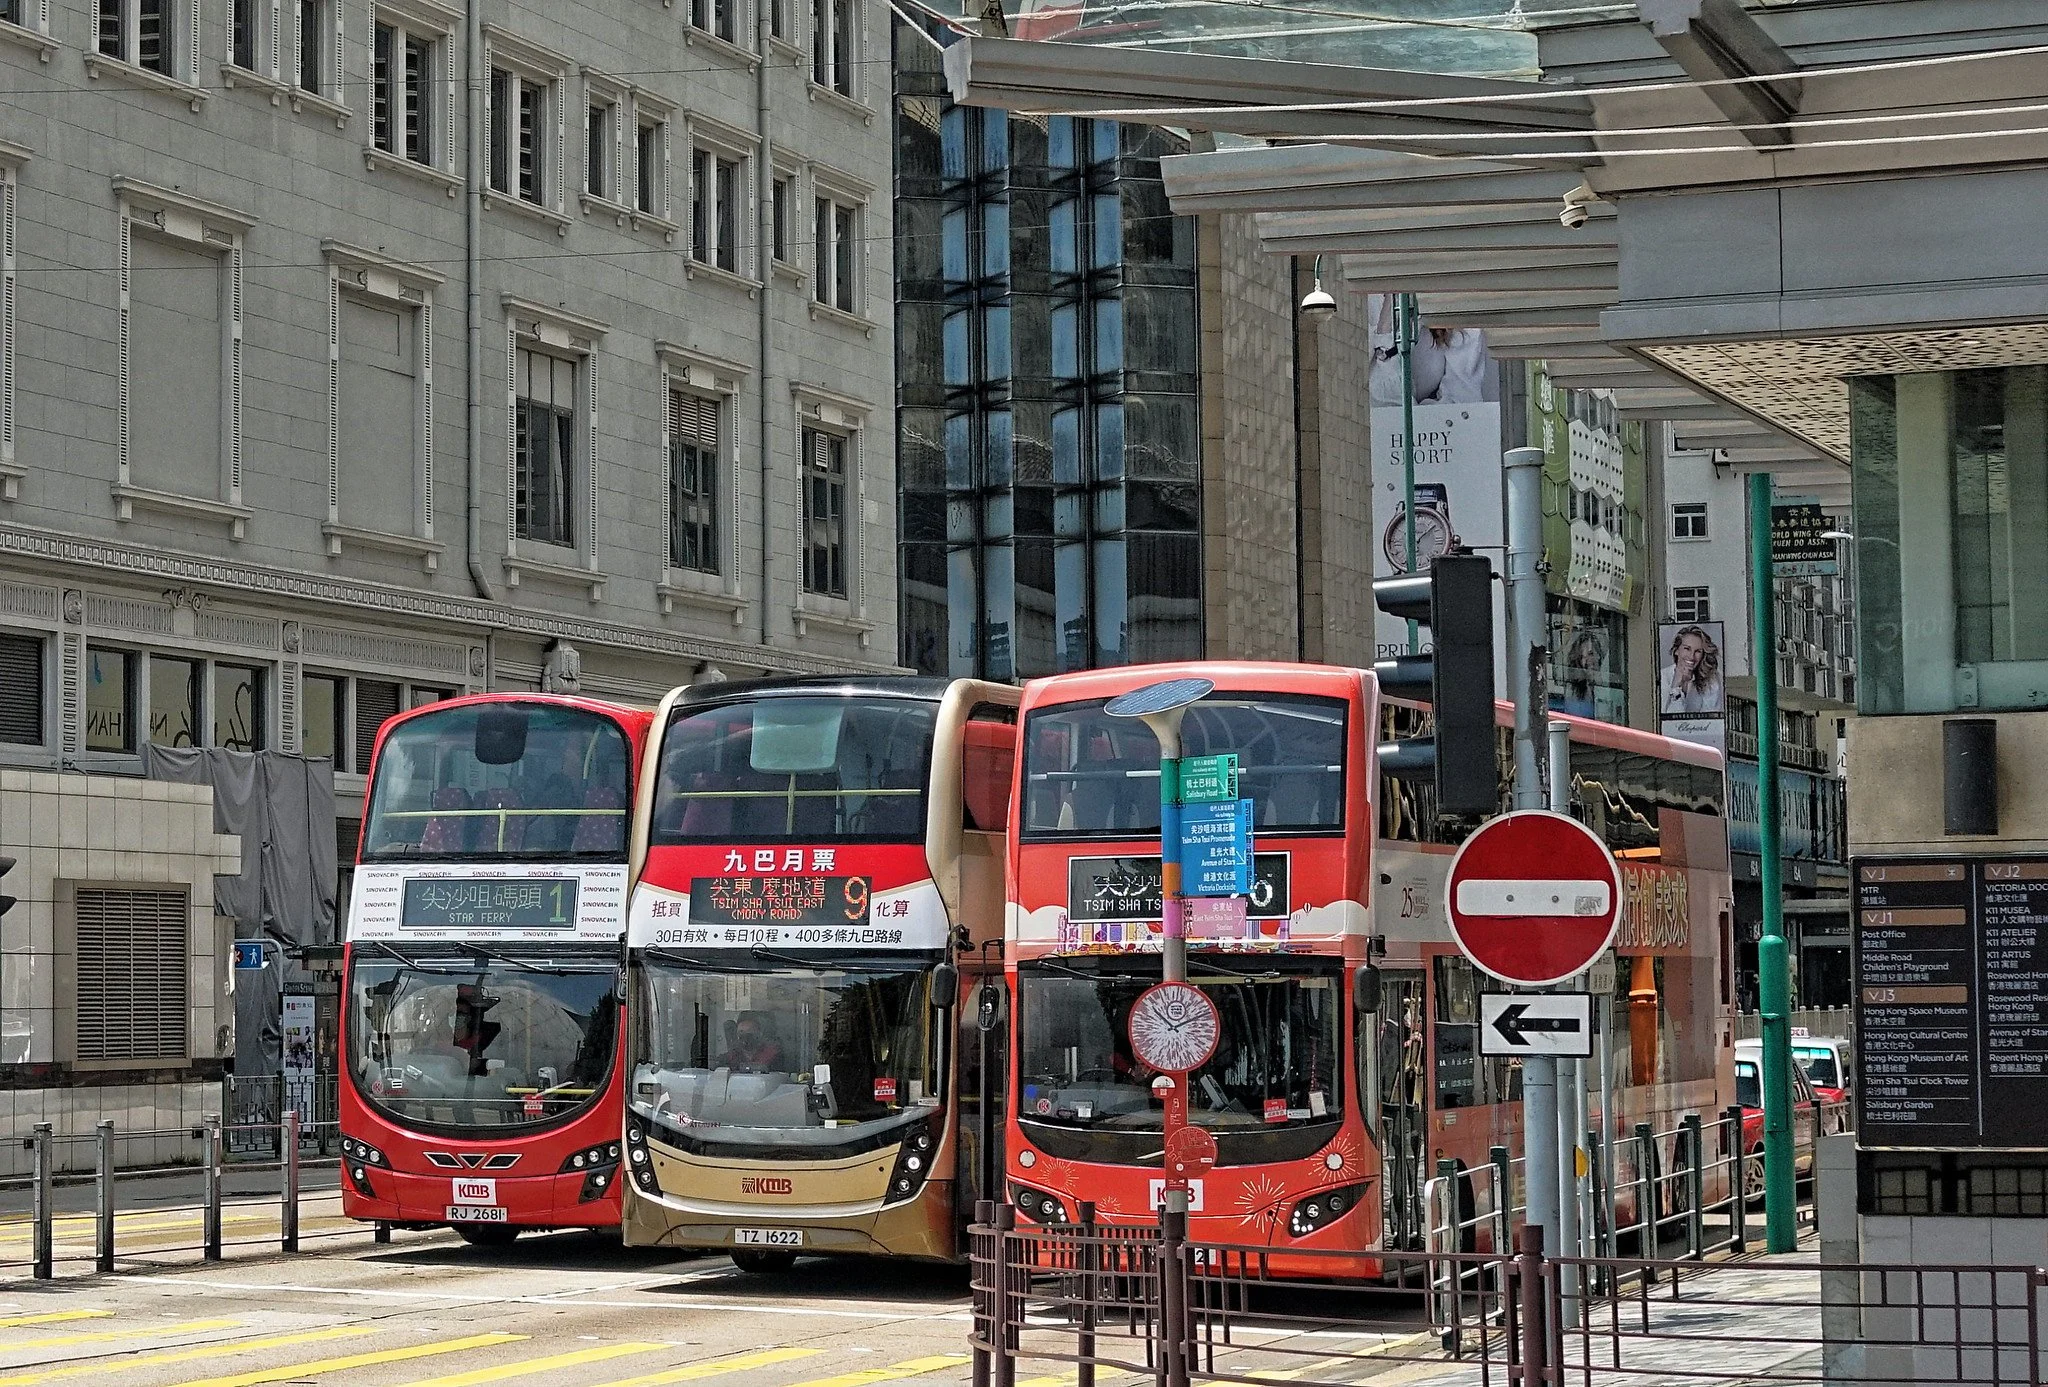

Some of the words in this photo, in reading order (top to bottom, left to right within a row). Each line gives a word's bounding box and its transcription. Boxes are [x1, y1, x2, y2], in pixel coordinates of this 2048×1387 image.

[1391, 431, 1450, 448] HPPY
[1390, 449, 1452, 465] SORT
[1772, 531, 1790, 539] ORLD
[1793, 530, 1811, 538] WING
[1186, 790, 1206, 798] Salisbury
[1210, 834, 1236, 842] Promenade
[724, 849, 835, 872] 九巴月票
[710, 877, 752, 897] 尖東
[1197, 884, 1215, 892] Victoria
[1215, 883, 1236, 891] Dockside
[1860, 886, 1879, 894] MTR
[1985, 883, 2027, 892] VICTORIA
[422, 884, 542, 910] 尖沙咀碼頭
[549, 882, 566, 922] 1
[844, 877, 868, 919] 9
[711, 897, 740, 909] TSIM
[743, 897, 763, 909] SHA
[767, 897, 794, 909] TSUI
[797, 897, 826, 909] EAST
[1084, 900, 1114, 912] TSIM
[1119, 900, 1141, 911] SHA
[1145, 899, 1162, 911] TS
[1401, 887, 1413, 918] 25
[652, 899, 682, 918] 抵買
[876, 899, 909, 918] 化算
[2000, 906, 2031, 914] MUSEA
[449, 912, 475, 922] STAR
[481, 912, 513, 922] FERRY
[1216, 923, 1233, 931] Station
[655, 929, 708, 943] 30日有效
[724, 928, 779, 942] 每日10程
[795, 928, 902, 943] 400多條九巴路線
[1861, 930, 1880, 939] Post
[1881, 930, 1907, 938] Office
[2000, 928, 2037, 937] ATELIER
[1862, 954, 1889, 962] Middle
[2001, 950, 2031, 959] ARTUS
[1903, 962, 1949, 972] Playground
[1987, 971, 2030, 980] Rosewood
[1988, 994, 2031, 1002] Rosewood
[1863, 1008, 1885, 1017] Hong
[1886, 1008, 1908, 1017] Kong
[1908, 1008, 1934, 1016] Space
[1935, 1007, 1968, 1015] Museum
[1988, 1002, 2011, 1012] Hong
[2011, 1002, 2034, 1012] Kong
[1864, 1032, 1886, 1041] Hong
[1887, 1032, 1909, 1041] Kong
[1909, 1031, 1940, 1040] Cultural
[1941, 1031, 1969, 1039] Centre
[1989, 1029, 2020, 1037] Avenue
[2021, 1028, 2030, 1036] of
[1864, 1055, 1887, 1064] Hong
[1888, 1055, 1909, 1064] Kong
[1910, 1054, 1944, 1062] Museum
[1945, 1054, 1954, 1062] of
[1955, 1054, 1969, 1062] Art
[1990, 1054, 2020, 1062] Regent
[2020, 1054, 2043, 1063] Hong
[1903, 1077, 1919, 1085] Tsui
[1919, 1077, 1943, 1085] Clock
[1944, 1077, 1969, 1085] Tower
[1866, 1101, 1903, 1110] Salisbury
[1903, 1101, 1934, 1109] Garden
[458, 1184, 490, 1198] KMB
[756, 1178, 793, 1195] KMB
[1157, 1187, 1196, 1203] KB
[451, 1209, 469, 1220] RJ
[473, 1209, 502, 1220] 2681
[741, 1231, 759, 1243] TZ
[766, 1231, 799, 1244] 1622
